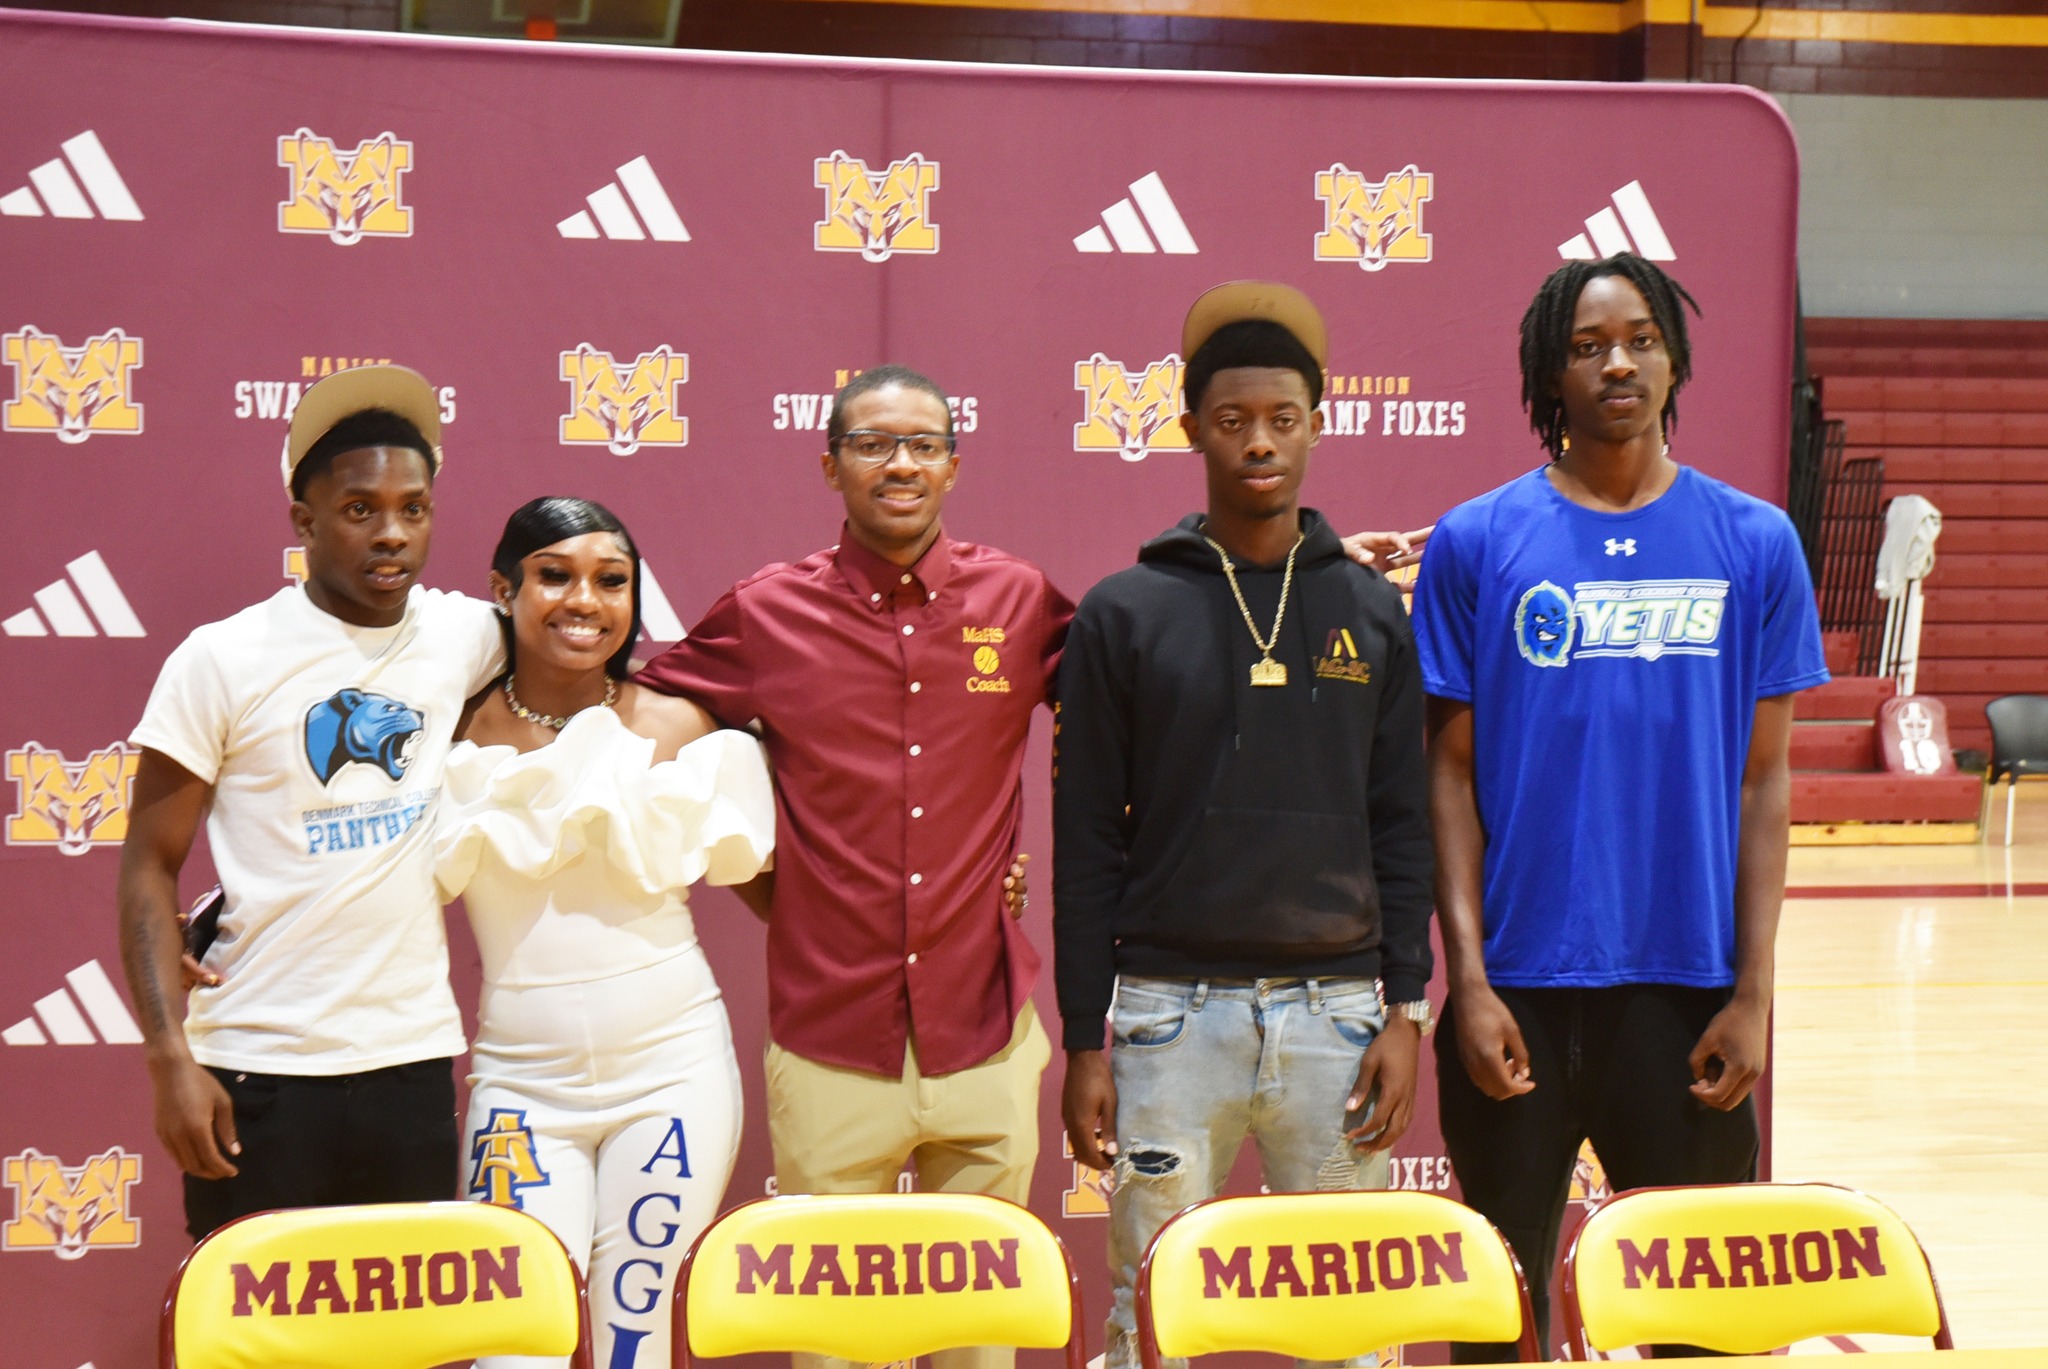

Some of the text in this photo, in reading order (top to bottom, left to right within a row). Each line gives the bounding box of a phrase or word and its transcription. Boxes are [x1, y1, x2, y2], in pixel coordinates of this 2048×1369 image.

[234, 380, 314, 420] SWA
[1331, 376, 1411, 395] MARION
[772, 394, 834, 430] SWA
[1318, 400, 1466, 436] AMP FOXES
[1575, 599, 1724, 643] YETIS
[966, 675, 1011, 693] Coach
[306, 803, 427, 855] PANTHE
[1387, 1156, 1451, 1191] OXES
[735, 1238, 1022, 1296] MARION
[1199, 1231, 1468, 1298] MARION
[1616, 1226, 1886, 1289] MARION
[230, 1245, 522, 1316] MARION
